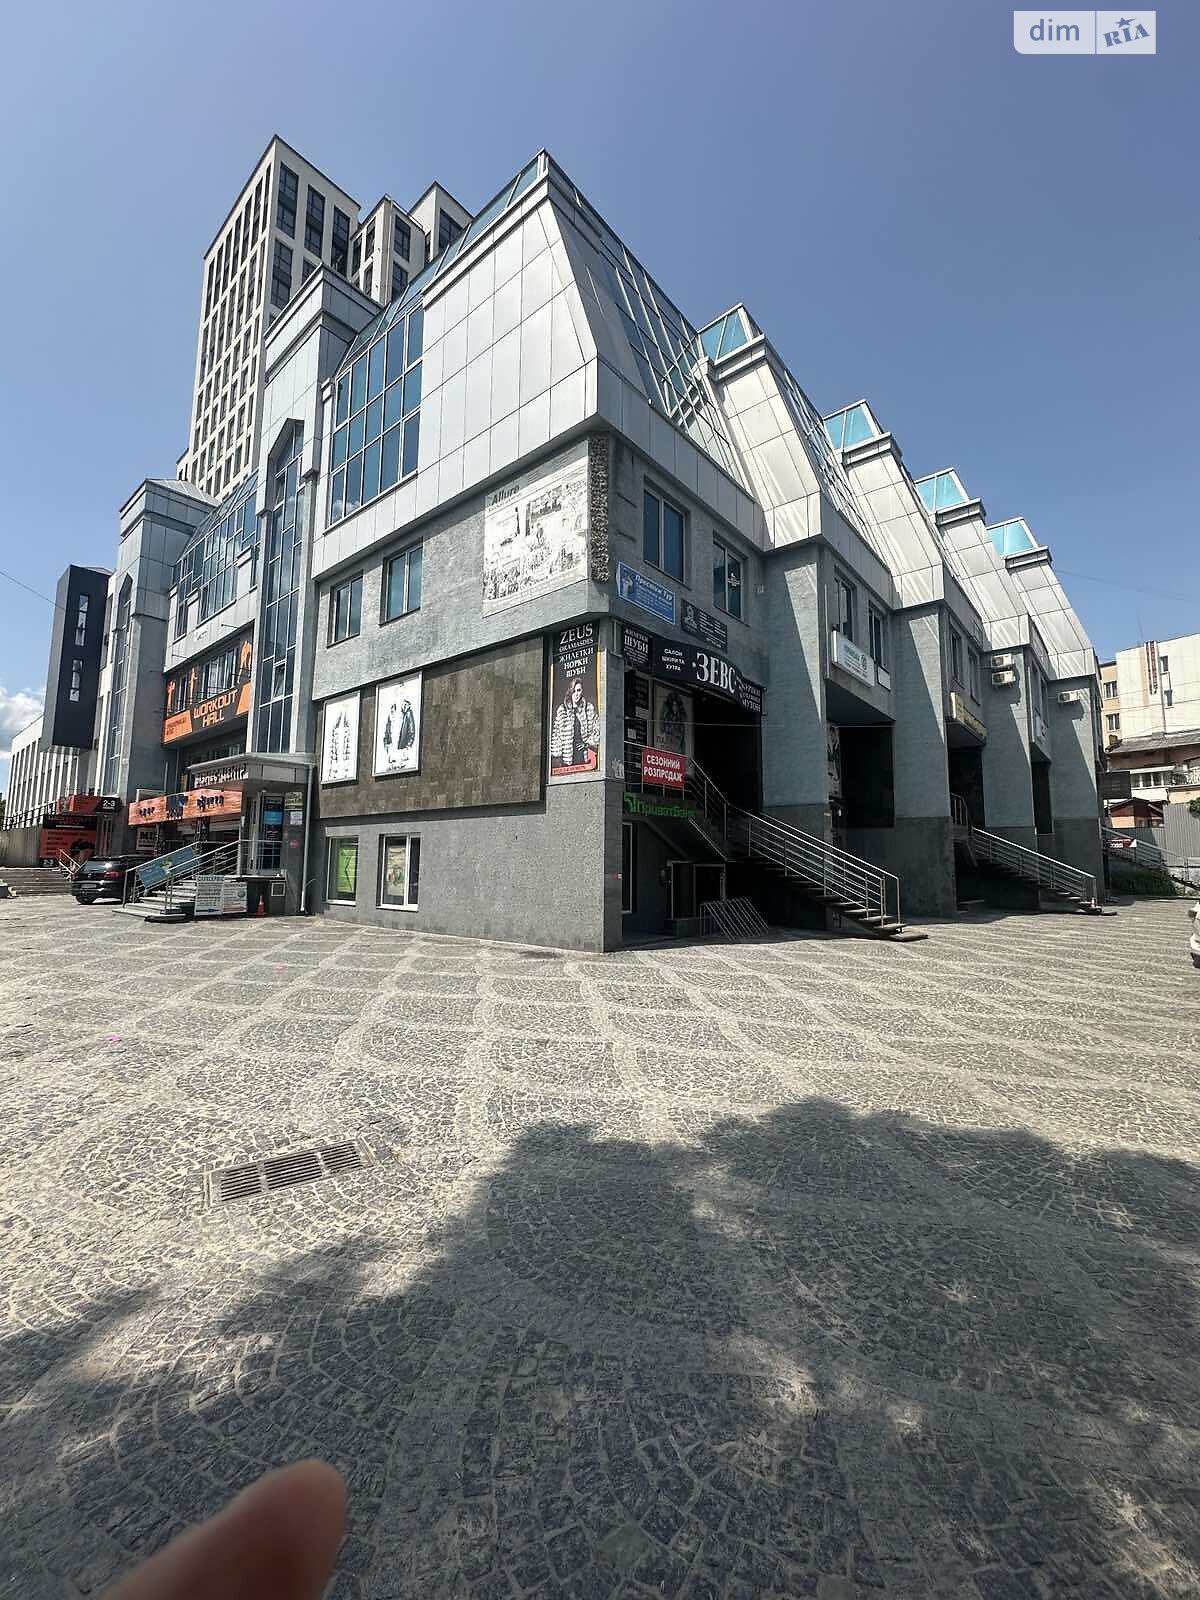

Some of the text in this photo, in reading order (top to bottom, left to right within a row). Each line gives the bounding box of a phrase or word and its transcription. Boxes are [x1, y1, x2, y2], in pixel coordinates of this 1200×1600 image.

[559, 623, 593, 645] ZEUS
[624, 635, 649, 654] ШУБИ
[663, 648, 683, 656] САЛОН
[559, 647, 594, 662] ЖИЛЕТКИ
[563, 657, 589, 670] НОРКИ
[566, 666, 586, 678] ШУБИ
[696, 652, 736, 693] ЗЕВС
[193, 689, 238, 718] WORKOUT
[202, 709, 225, 727] HALL
[646, 755, 681, 769] СЕЗОННИЙ
[644, 766, 683, 782] РОЗПРОДАЖ
[102, 799, 116, 807] 2-3
